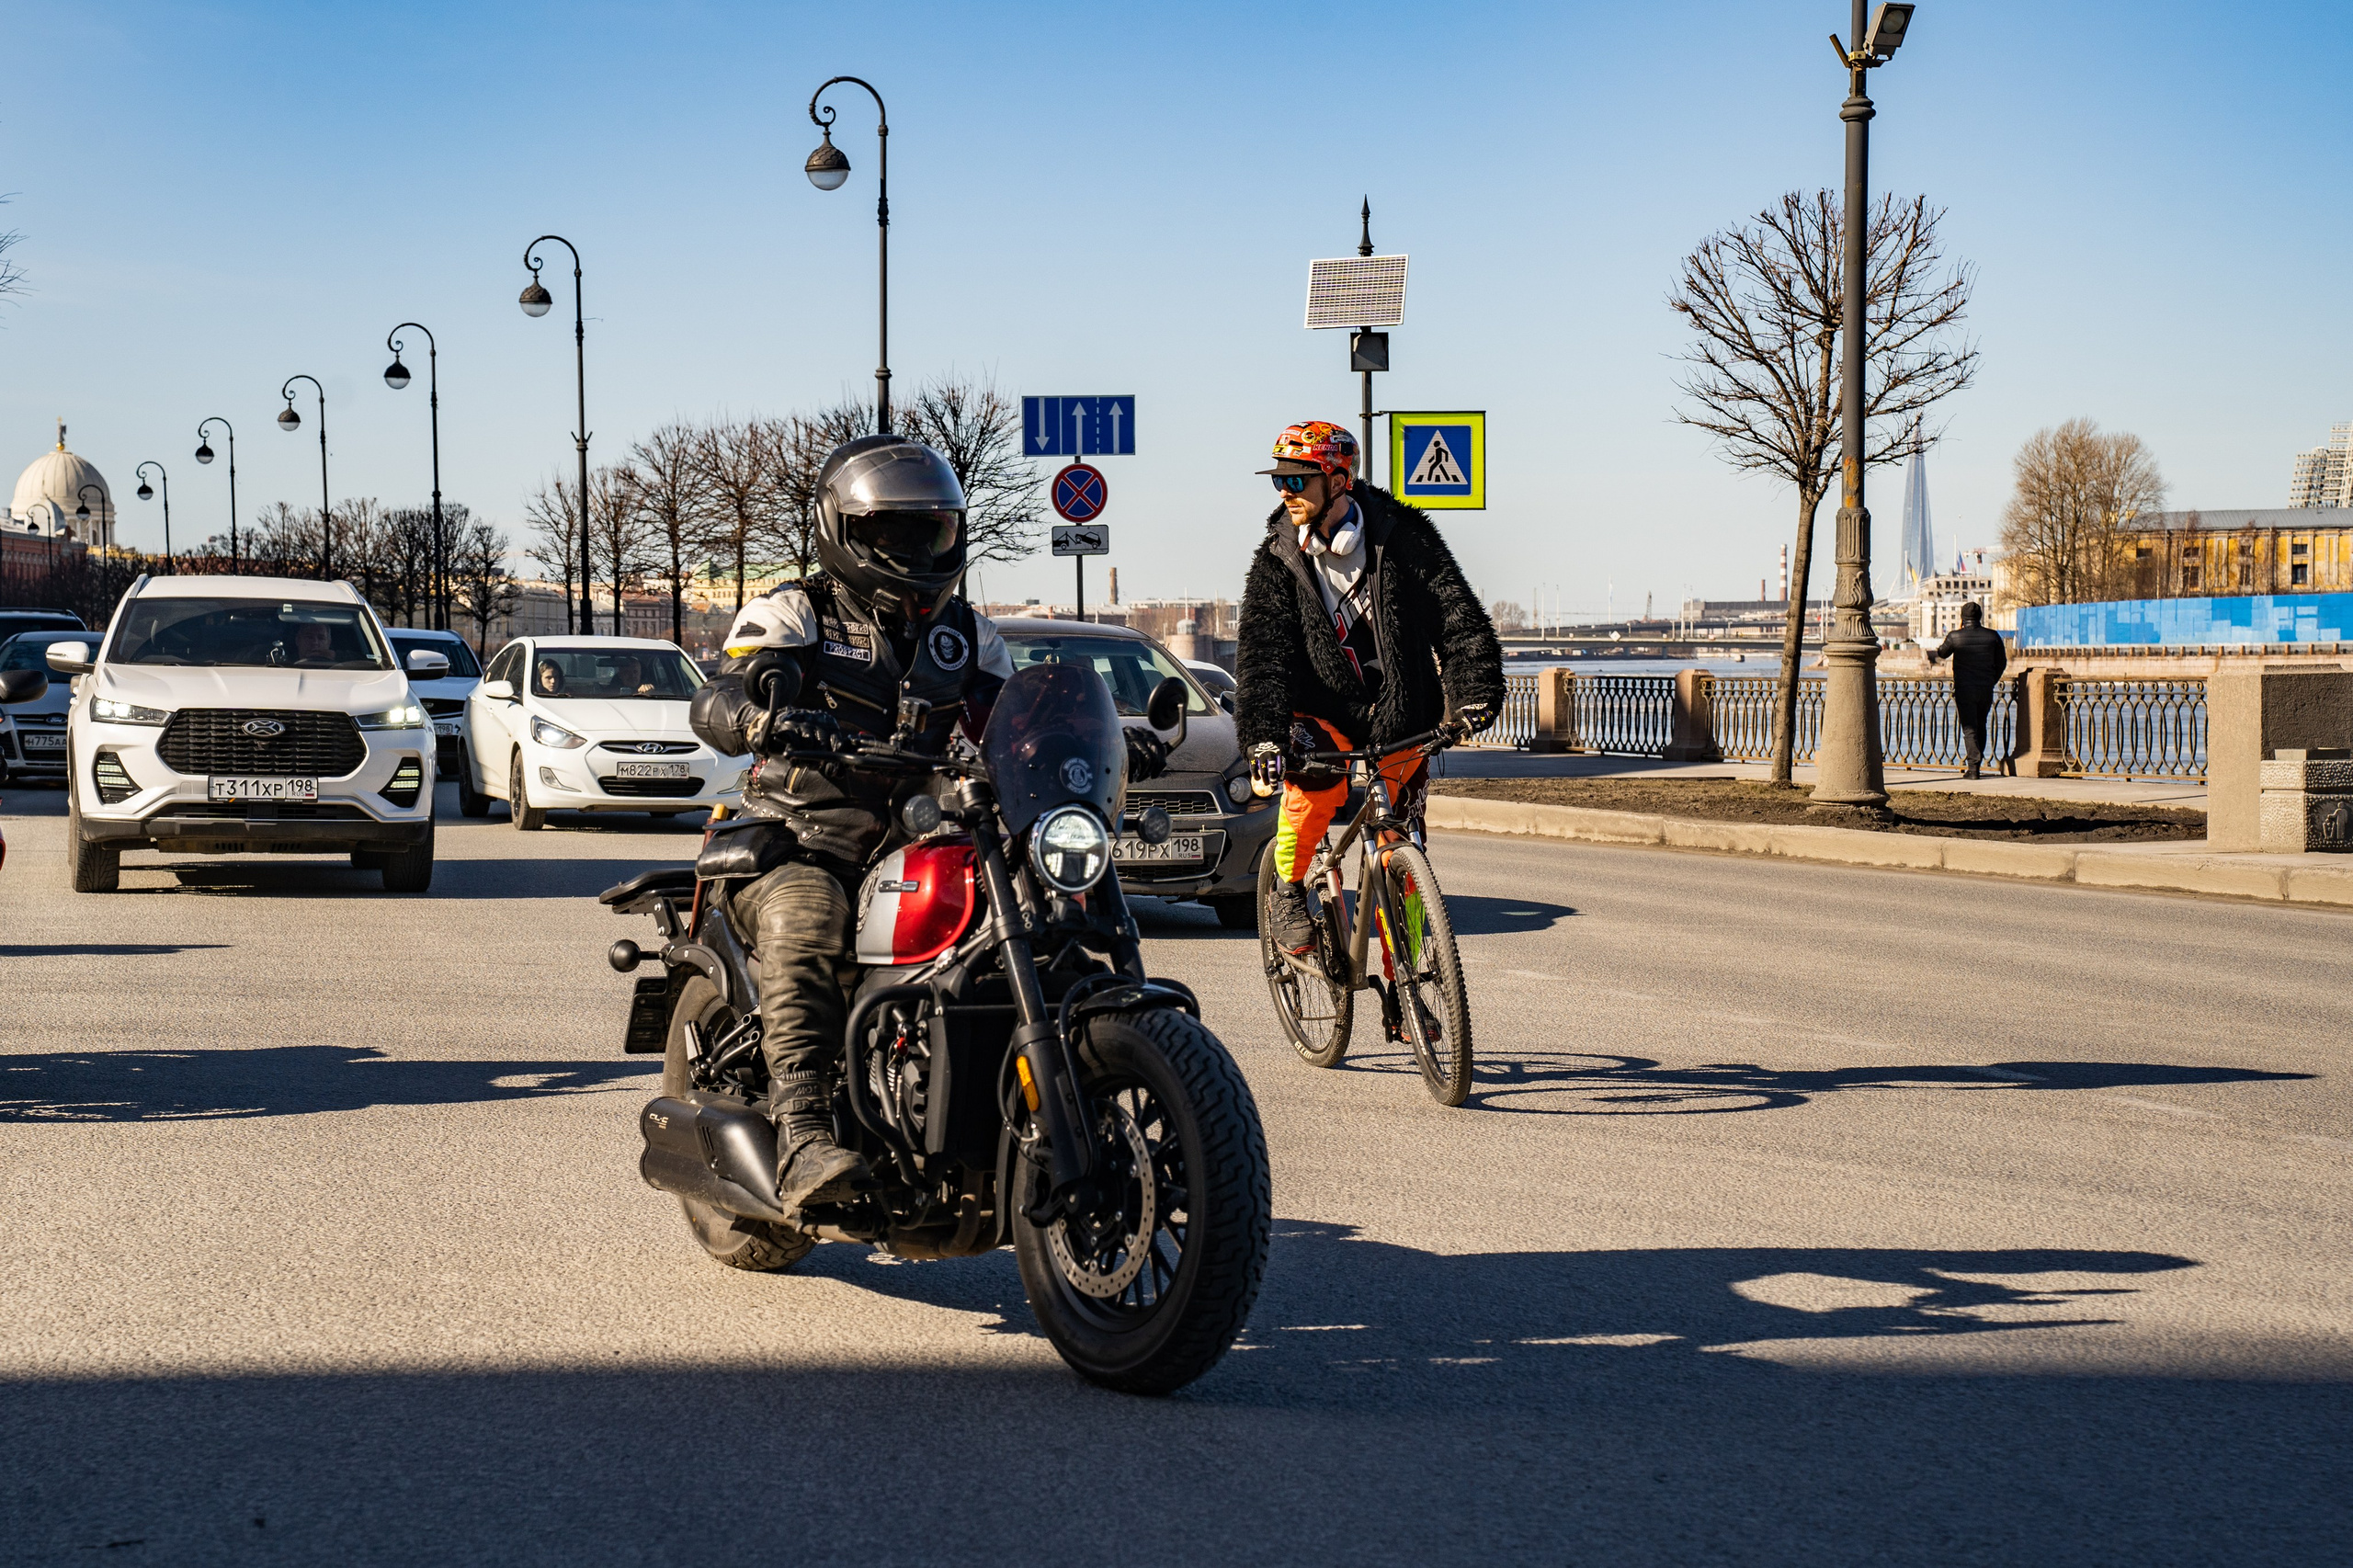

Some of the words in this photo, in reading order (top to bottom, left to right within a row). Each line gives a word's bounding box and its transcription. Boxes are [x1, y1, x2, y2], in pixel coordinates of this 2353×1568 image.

[669, 765, 686, 773] 178
[287, 779, 313, 792] 198
[1173, 838, 1199, 853] 198
